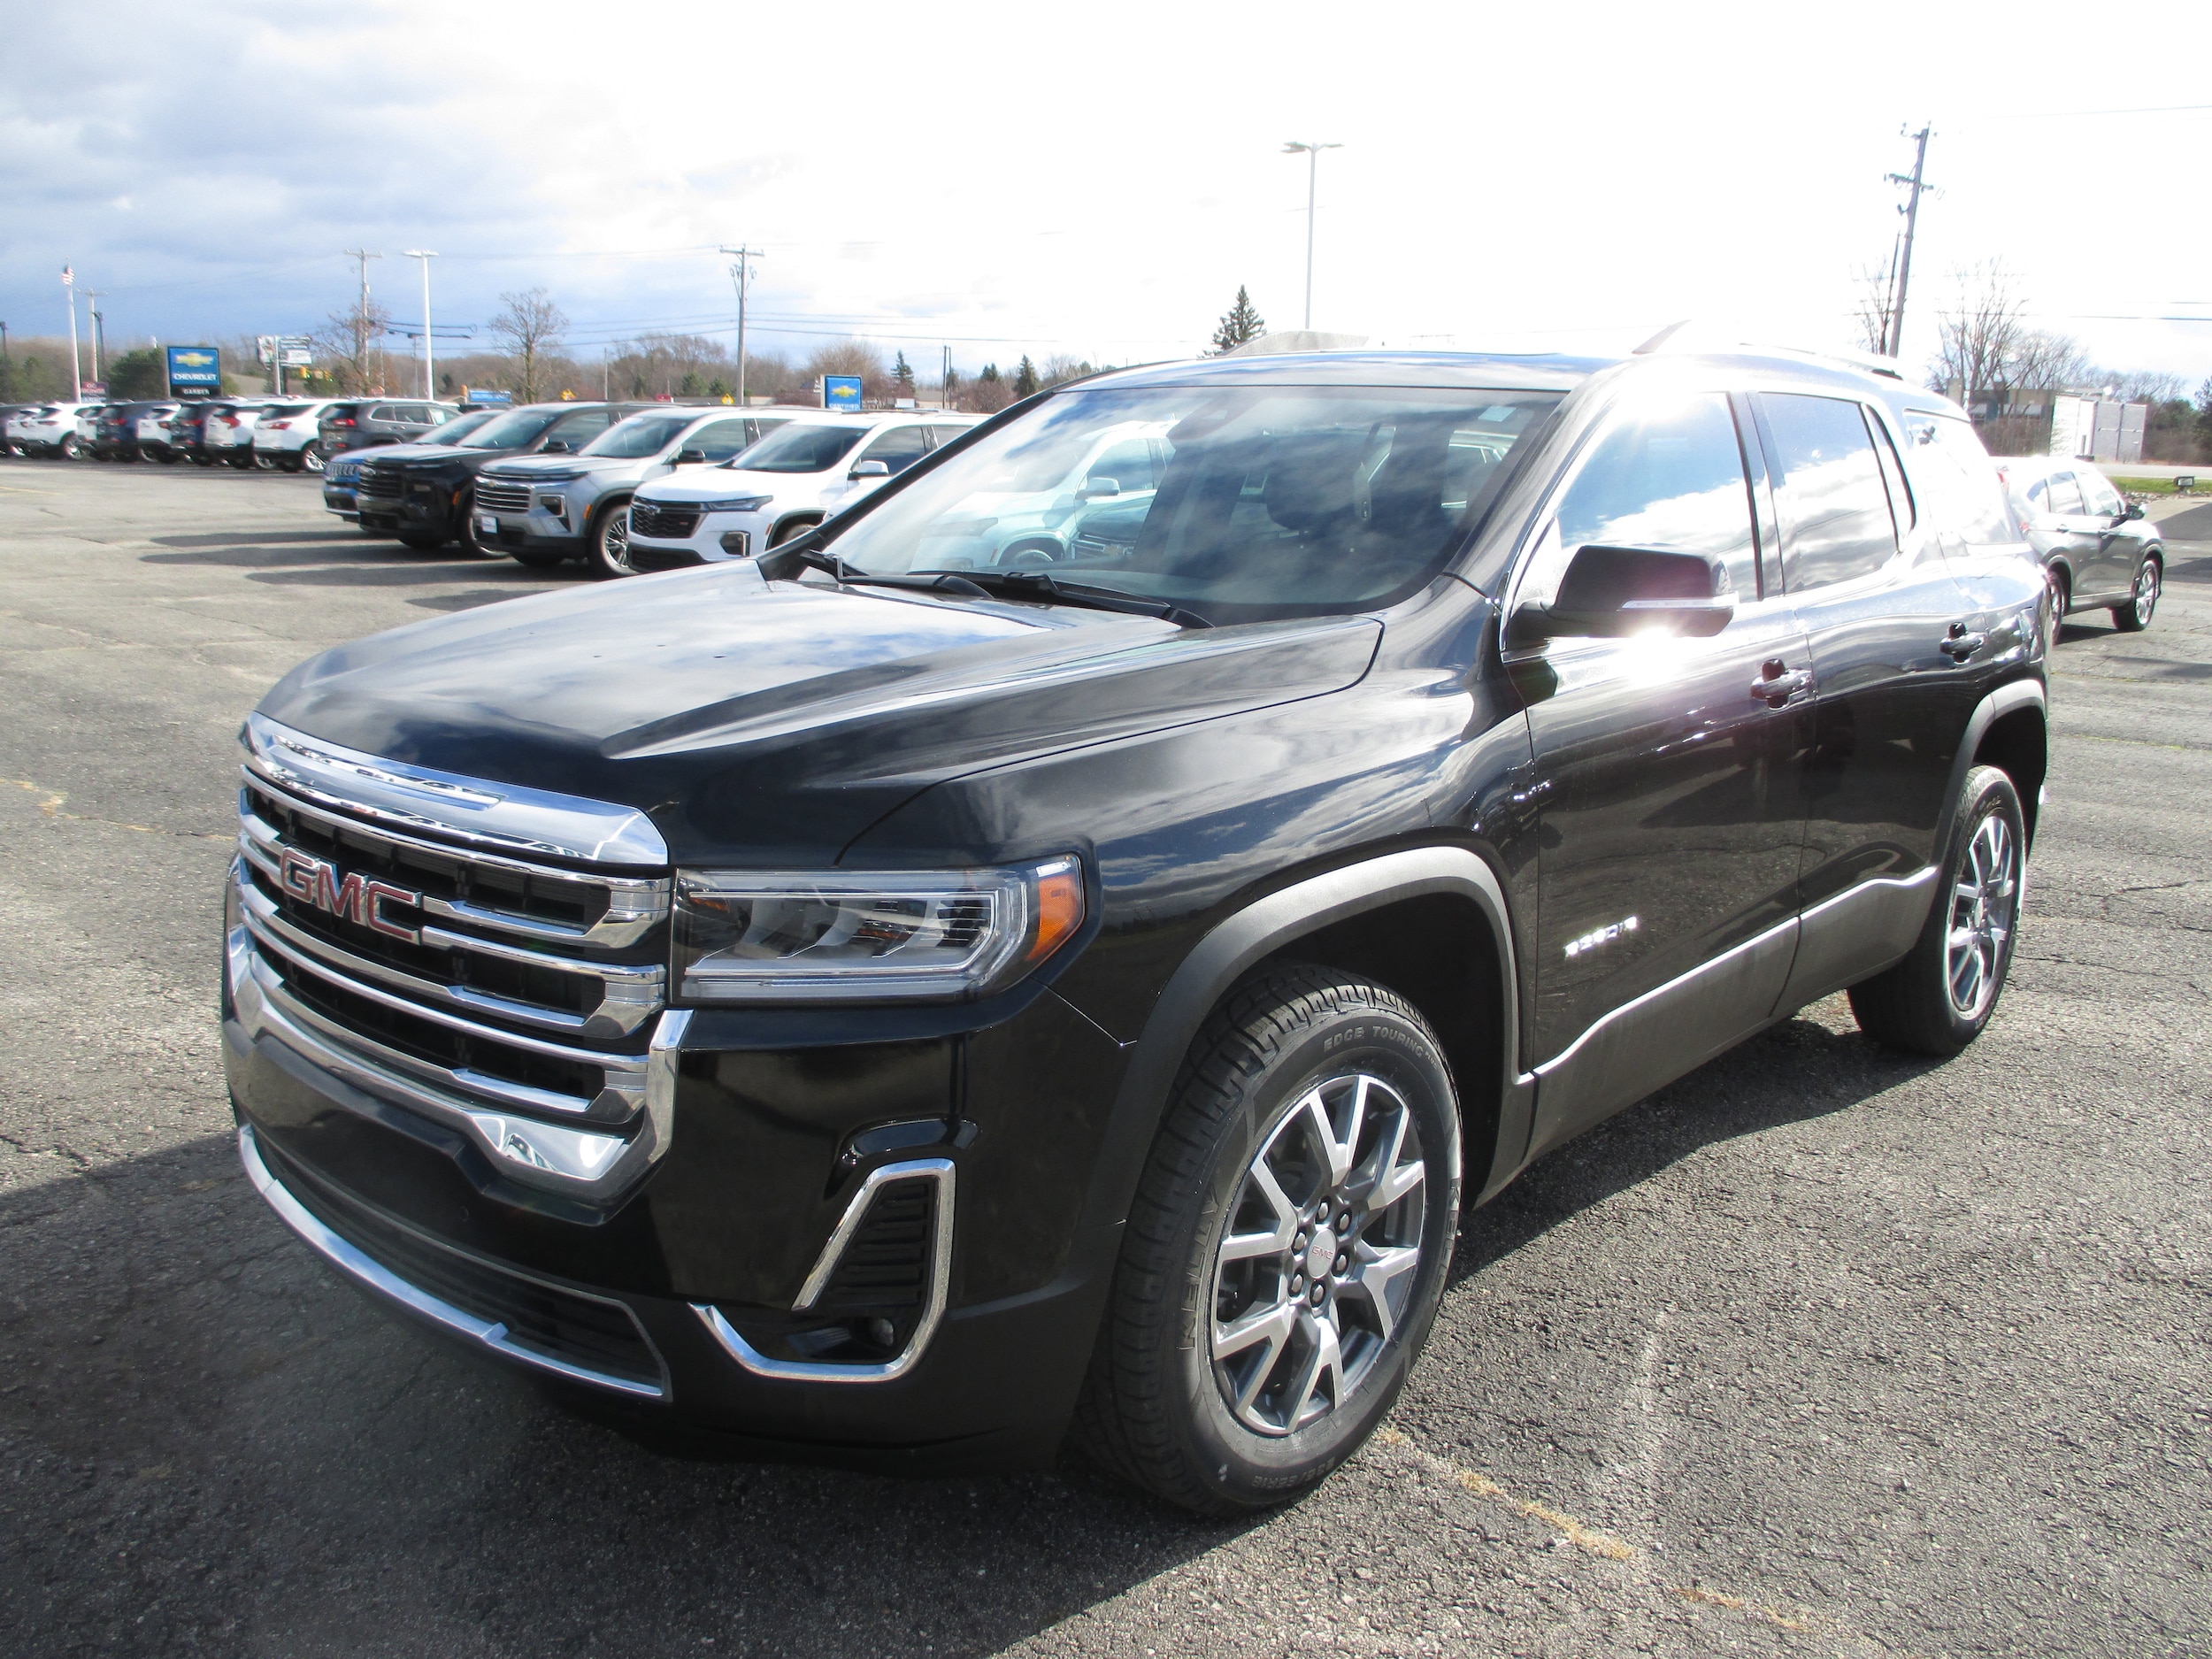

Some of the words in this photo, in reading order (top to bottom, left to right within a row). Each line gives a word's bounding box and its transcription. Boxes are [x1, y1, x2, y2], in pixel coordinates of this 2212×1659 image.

[280, 847, 422, 946] GMC
[1323, 1026, 1365, 1052] EDGE
[1372, 1025, 1424, 1058] TOURING
[1175, 1182, 1219, 1351] KELLY
[1311, 1245, 1334, 1260] GMC
